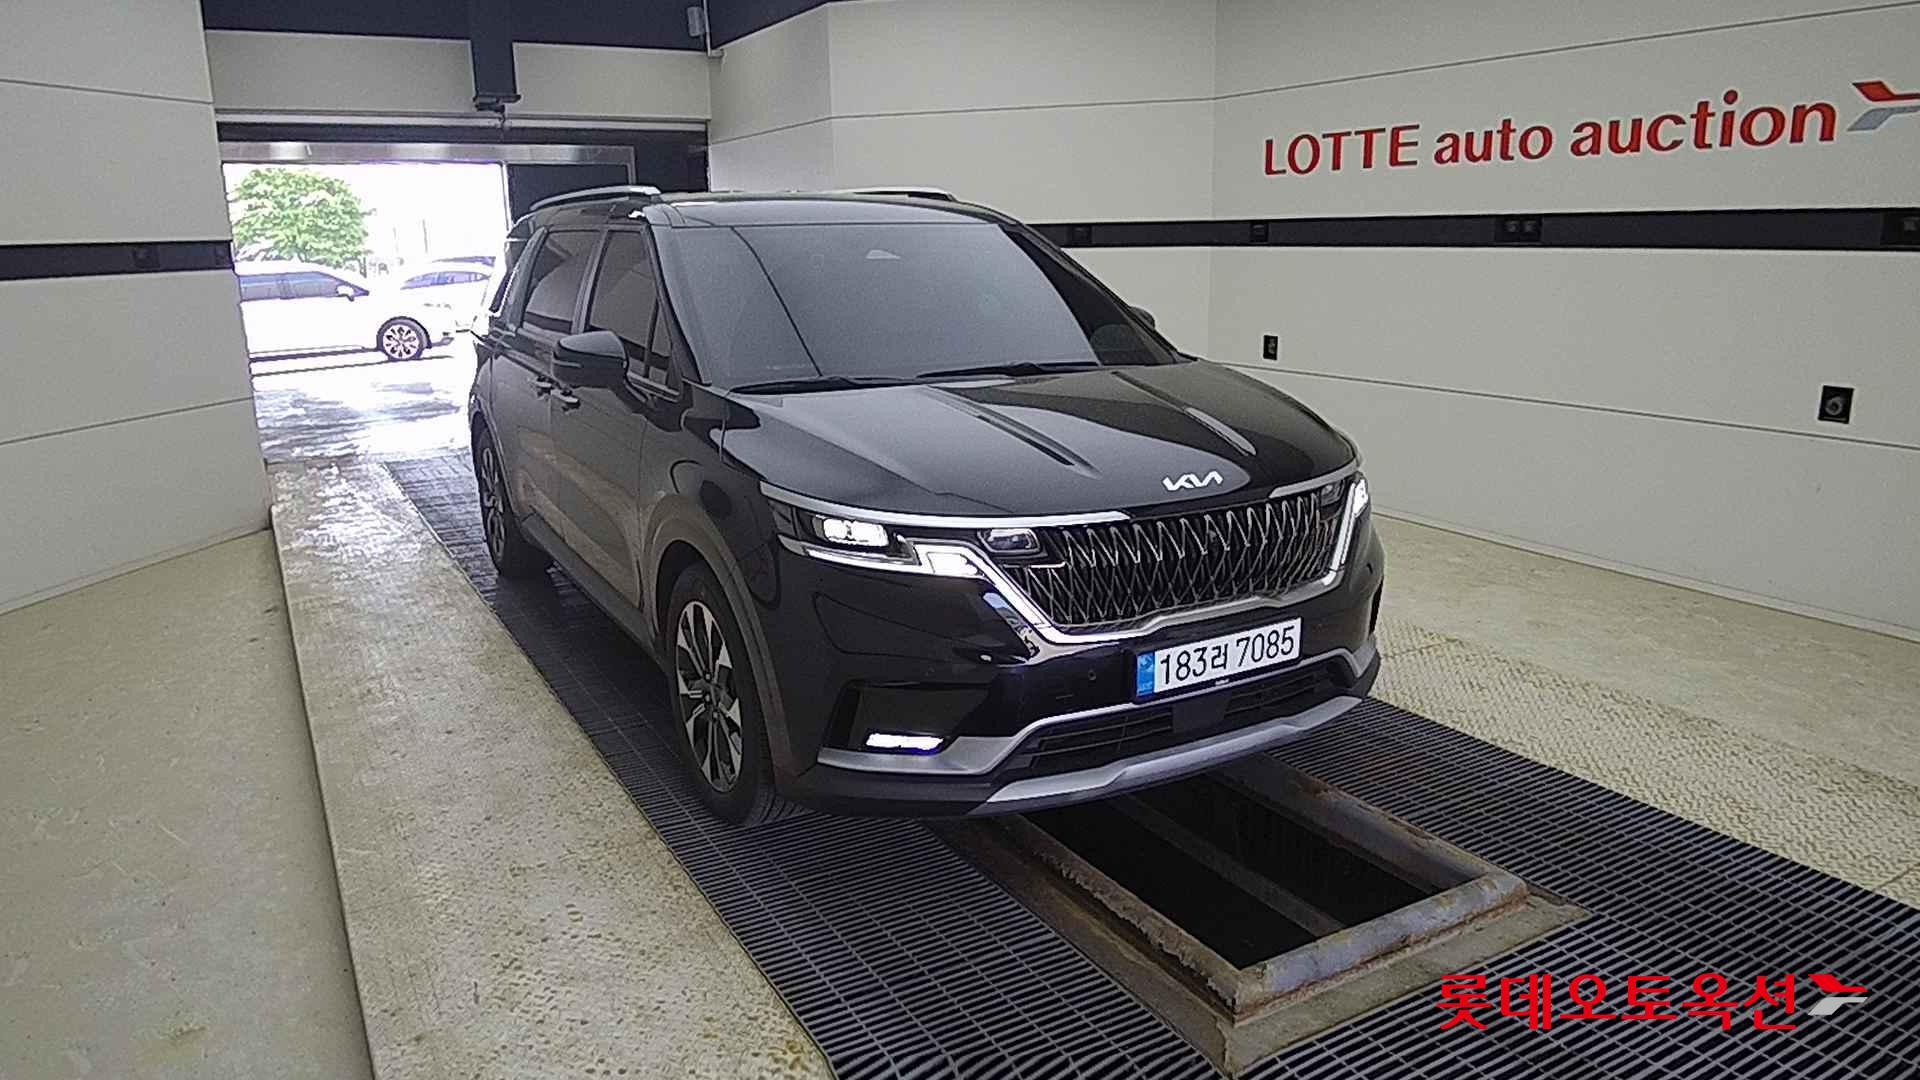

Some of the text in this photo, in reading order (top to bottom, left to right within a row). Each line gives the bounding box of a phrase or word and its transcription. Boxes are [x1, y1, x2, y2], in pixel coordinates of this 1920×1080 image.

[1264, 89, 1837, 176] LOTTE auto auction
[1162, 471, 1222, 491] KIA
[1160, 626, 1295, 684] 183러 7085
